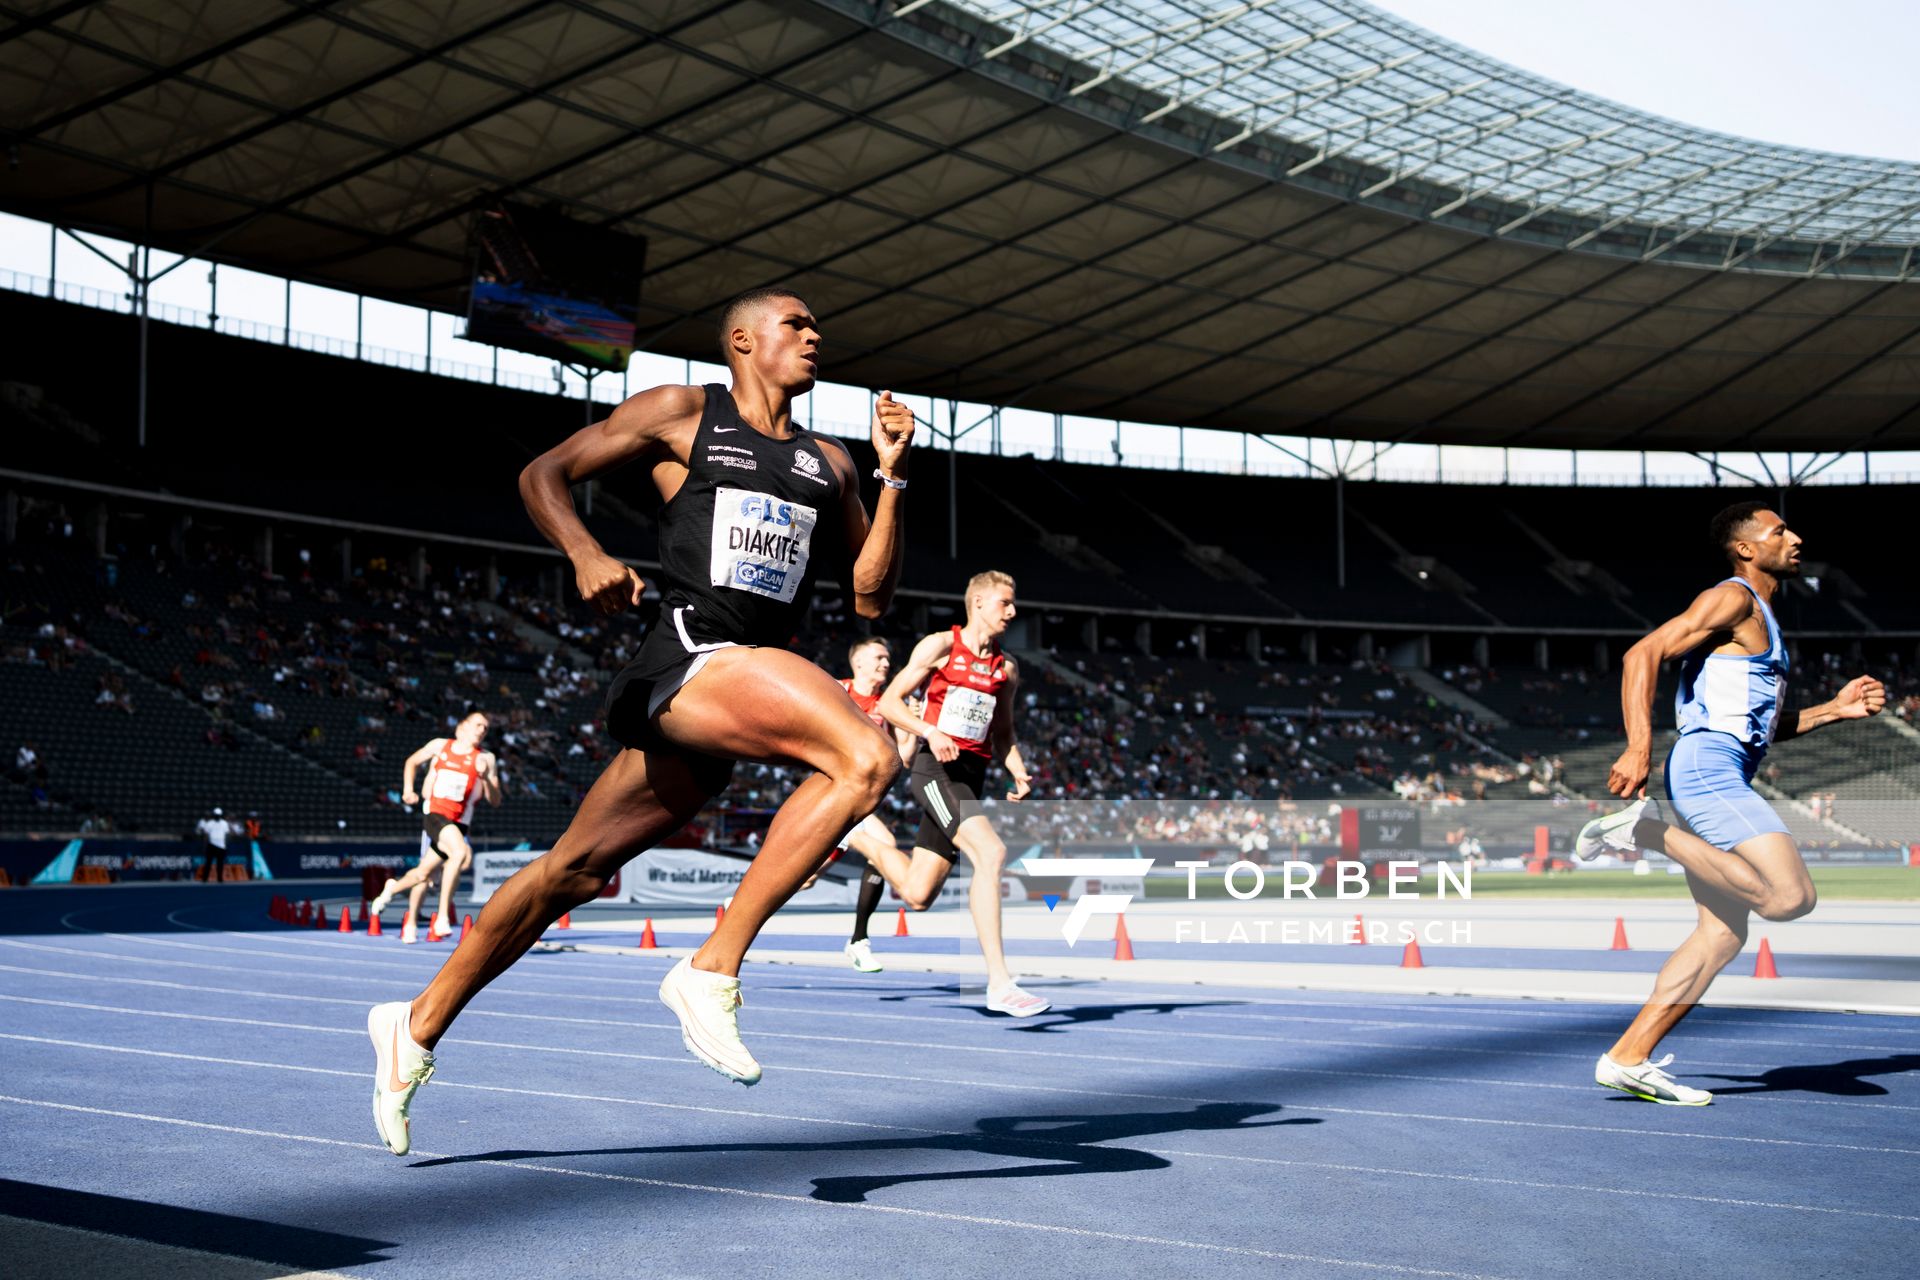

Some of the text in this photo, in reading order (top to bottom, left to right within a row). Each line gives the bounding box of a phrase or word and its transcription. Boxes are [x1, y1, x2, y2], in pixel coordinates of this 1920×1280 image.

[707, 455, 757, 466] BUNDESPOLIZEI
[722, 460, 757, 471] Spitzensport
[794, 449, 821, 475] 96
[729, 526, 800, 565] DIAKITÉ
[671, 868, 696, 884] sind
